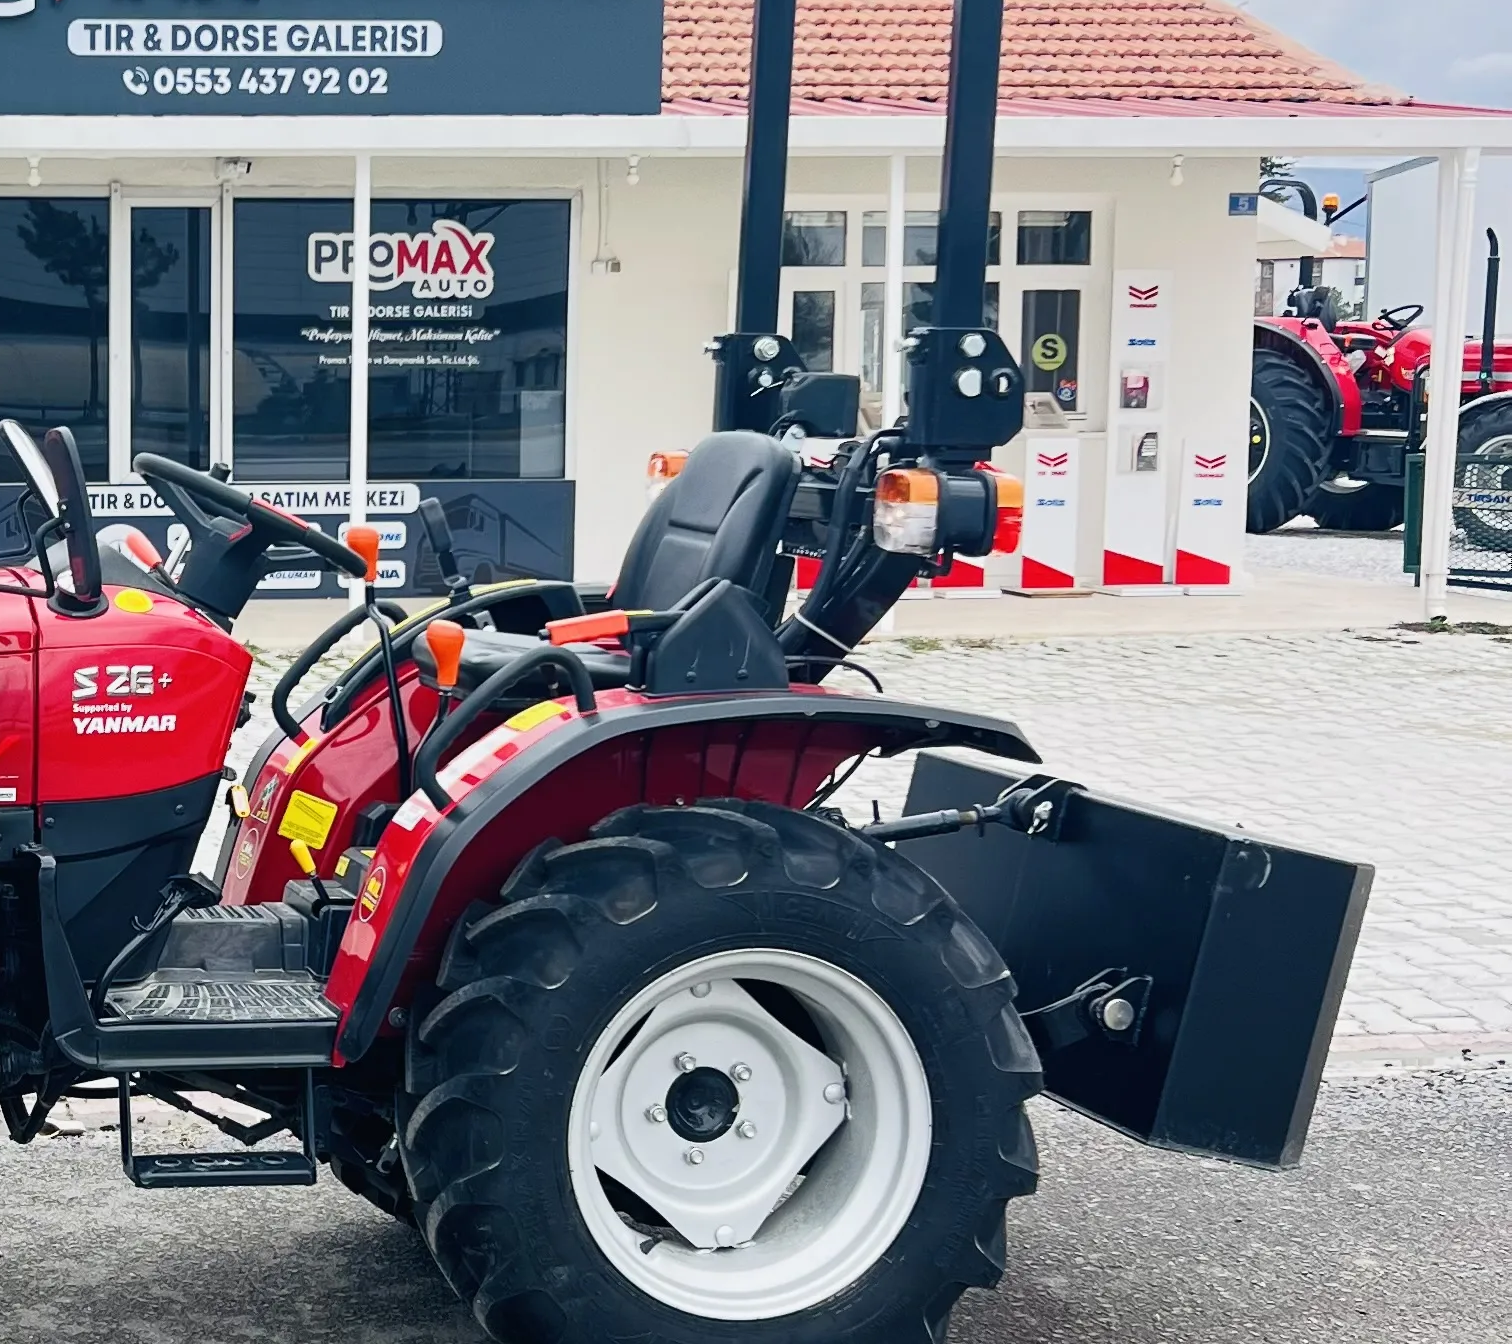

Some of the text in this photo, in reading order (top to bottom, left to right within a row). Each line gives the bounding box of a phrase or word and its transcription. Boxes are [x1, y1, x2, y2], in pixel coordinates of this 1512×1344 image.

[83, 24, 135, 53] TIR
[144, 24, 163, 53] &
[171, 24, 278, 53] DORSE
[153, 67, 389, 96] 0553 437 92 02
[419, 280, 487, 292] AUTO
[329, 306, 350, 318] TIR
[1041, 338, 1058, 360] S
[88, 494, 118, 509] TIR
[123, 493, 135, 508] &
[72, 666, 100, 702] S
[72, 703, 133, 714] Supported by
[72, 715, 177, 734] YANMAR
